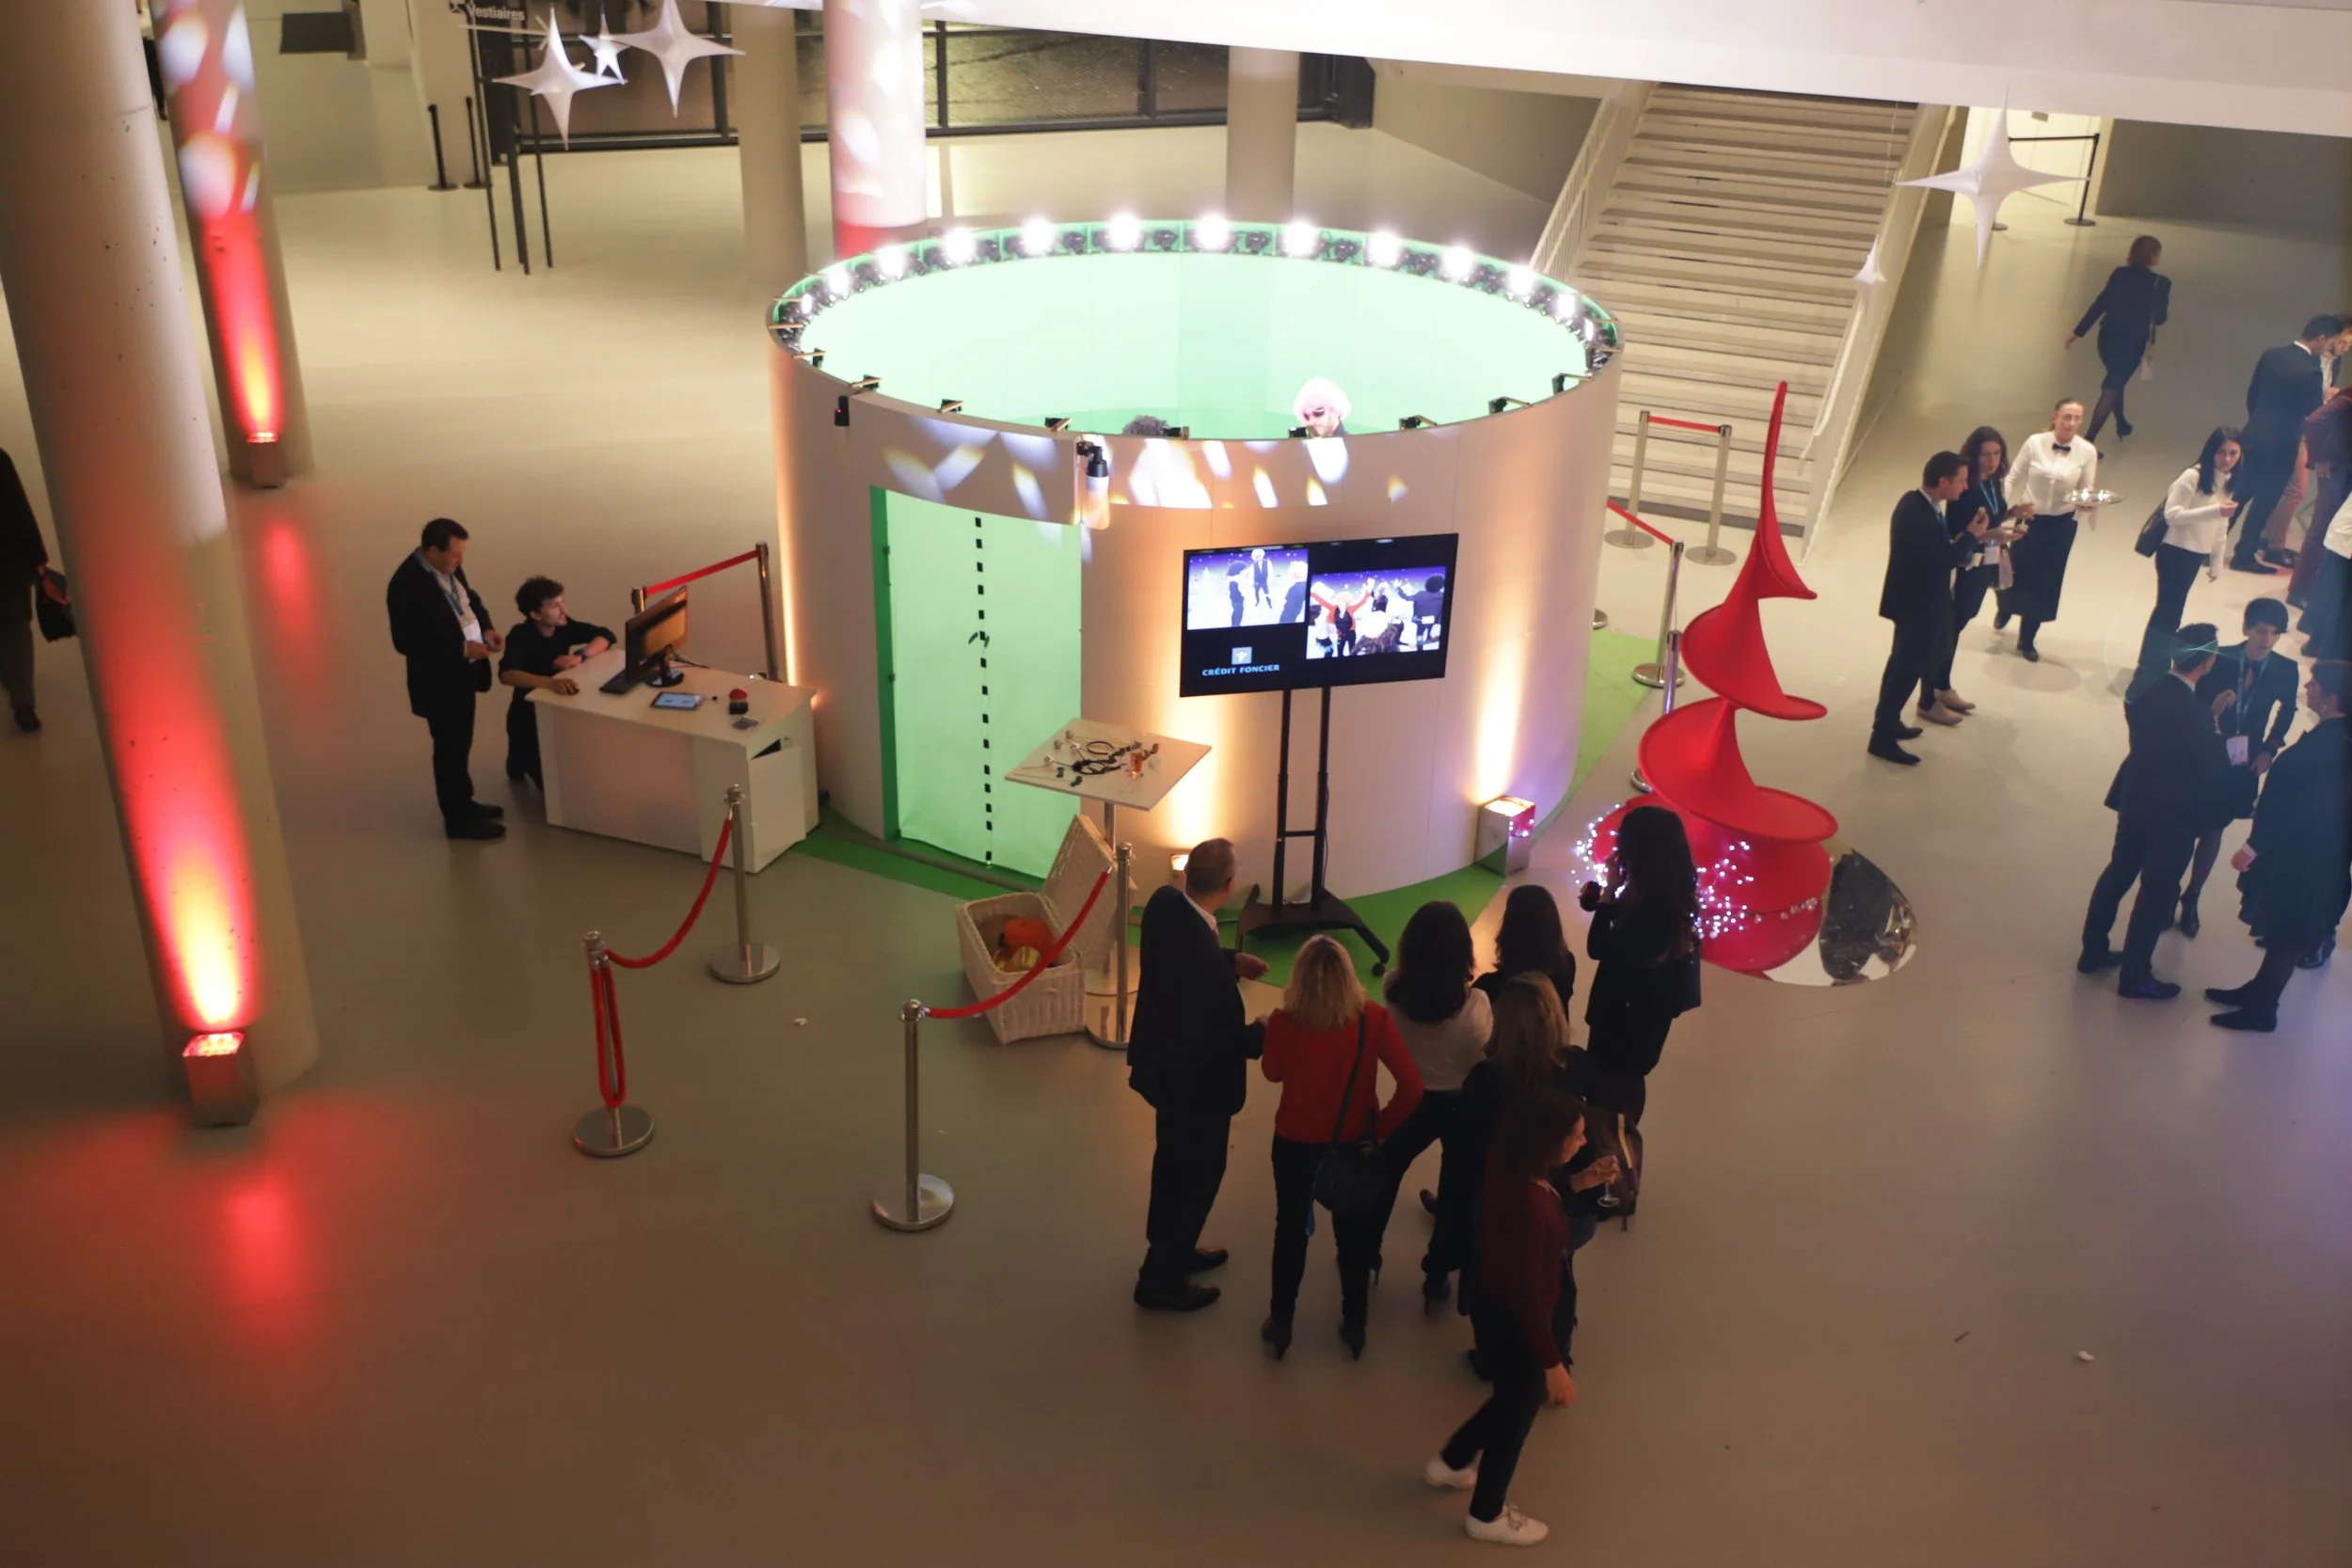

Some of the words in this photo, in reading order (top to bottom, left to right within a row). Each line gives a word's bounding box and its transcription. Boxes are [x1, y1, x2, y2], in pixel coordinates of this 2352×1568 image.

[467, 4, 525, 21] Vestiaires
[1201, 666, 1237, 676] CRÉDIT
[1240, 664, 1280, 673] FONCIER
